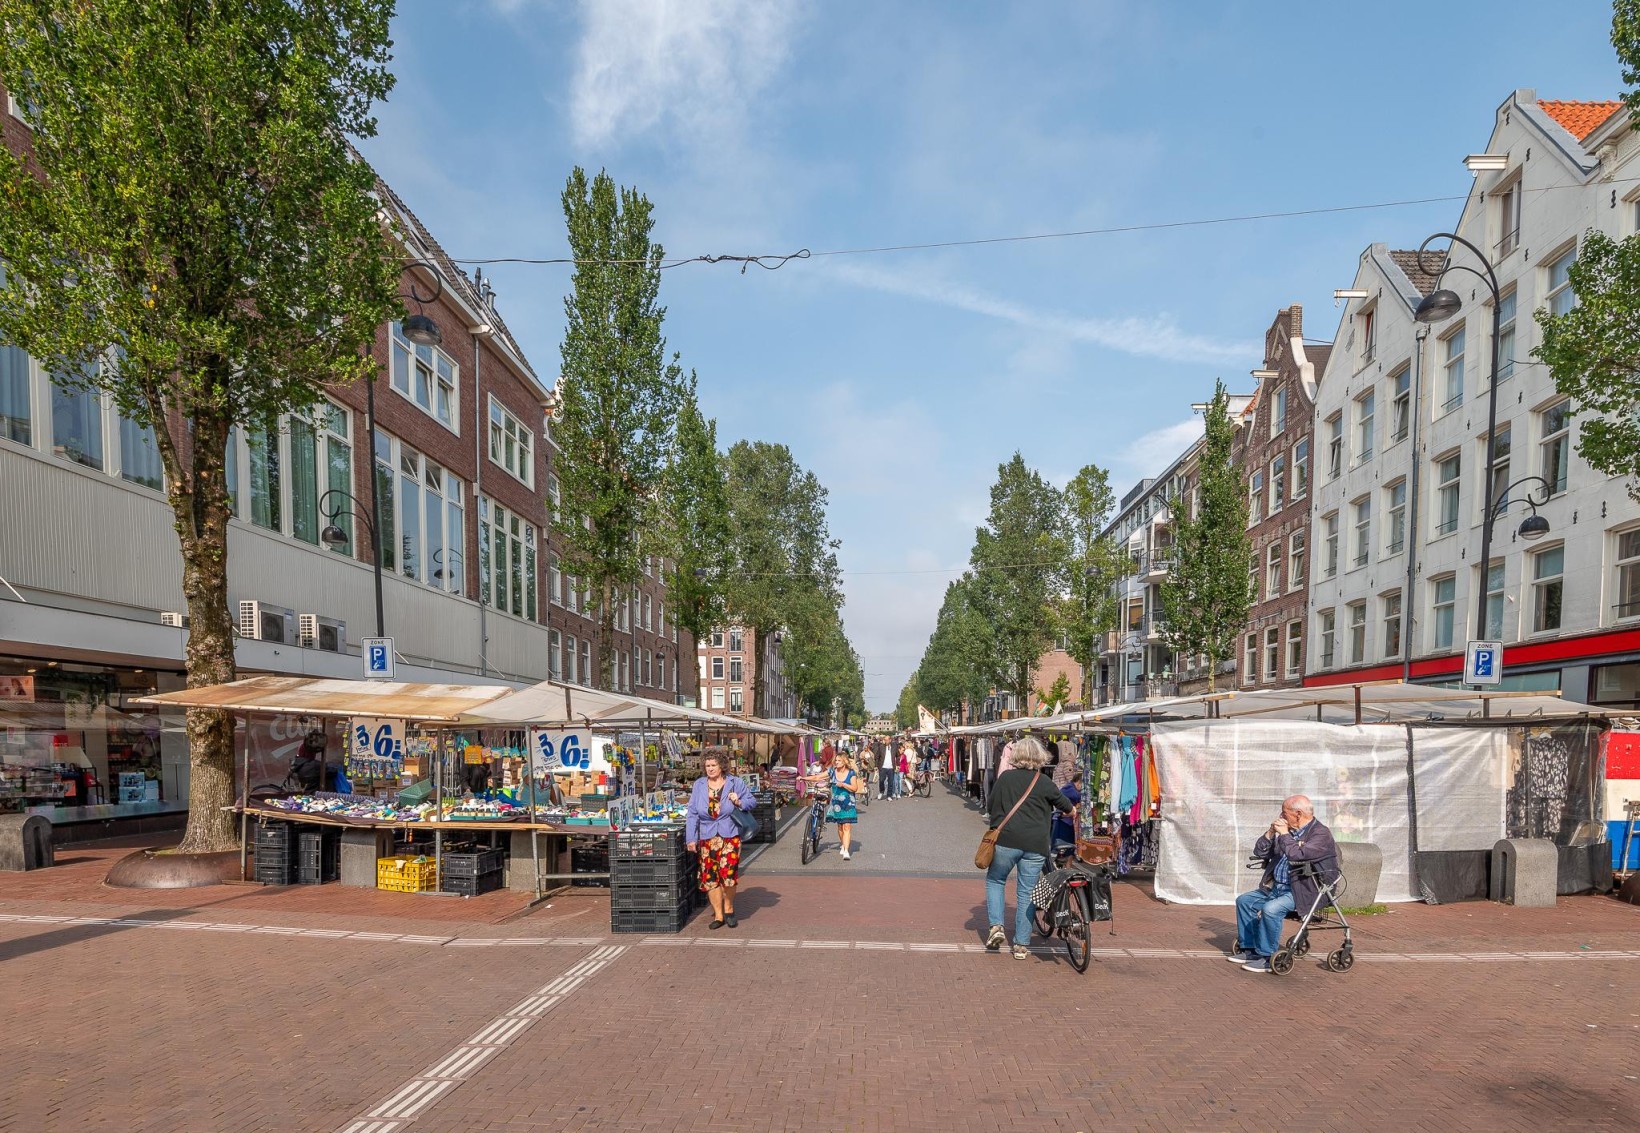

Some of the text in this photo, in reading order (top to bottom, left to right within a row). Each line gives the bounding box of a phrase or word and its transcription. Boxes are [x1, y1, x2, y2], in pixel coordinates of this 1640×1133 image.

[374, 648, 383, 661] P
[1479, 652, 1490, 665] P
[355, 724, 370, 747] 3
[538, 733, 555, 757] 3
